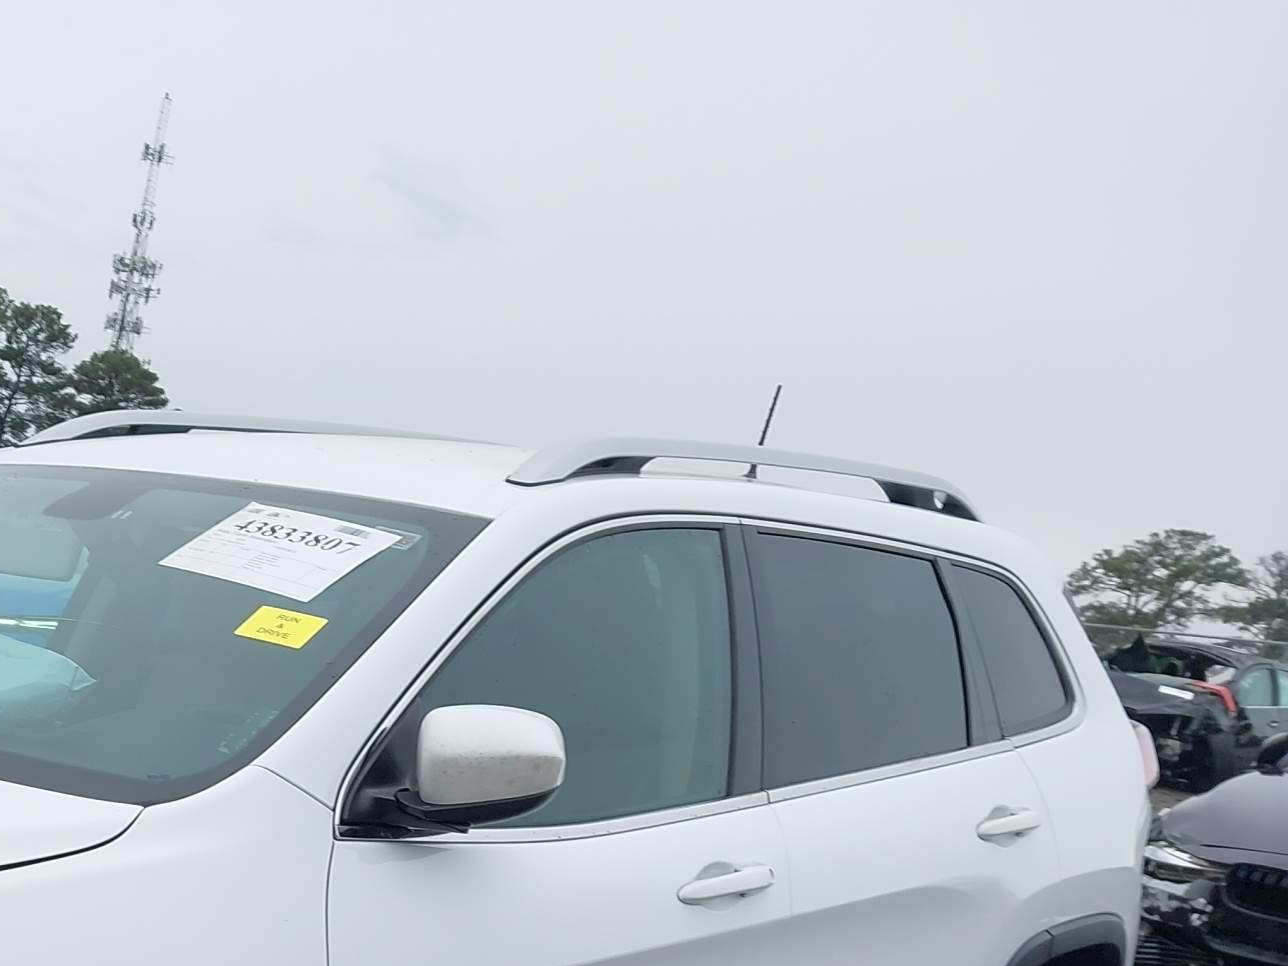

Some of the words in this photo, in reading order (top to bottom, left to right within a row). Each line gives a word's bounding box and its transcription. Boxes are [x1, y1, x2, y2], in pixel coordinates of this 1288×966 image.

[234, 519, 361, 555] 43833807
[276, 613, 303, 624] RUN
[256, 626, 293, 640] DRIVE
